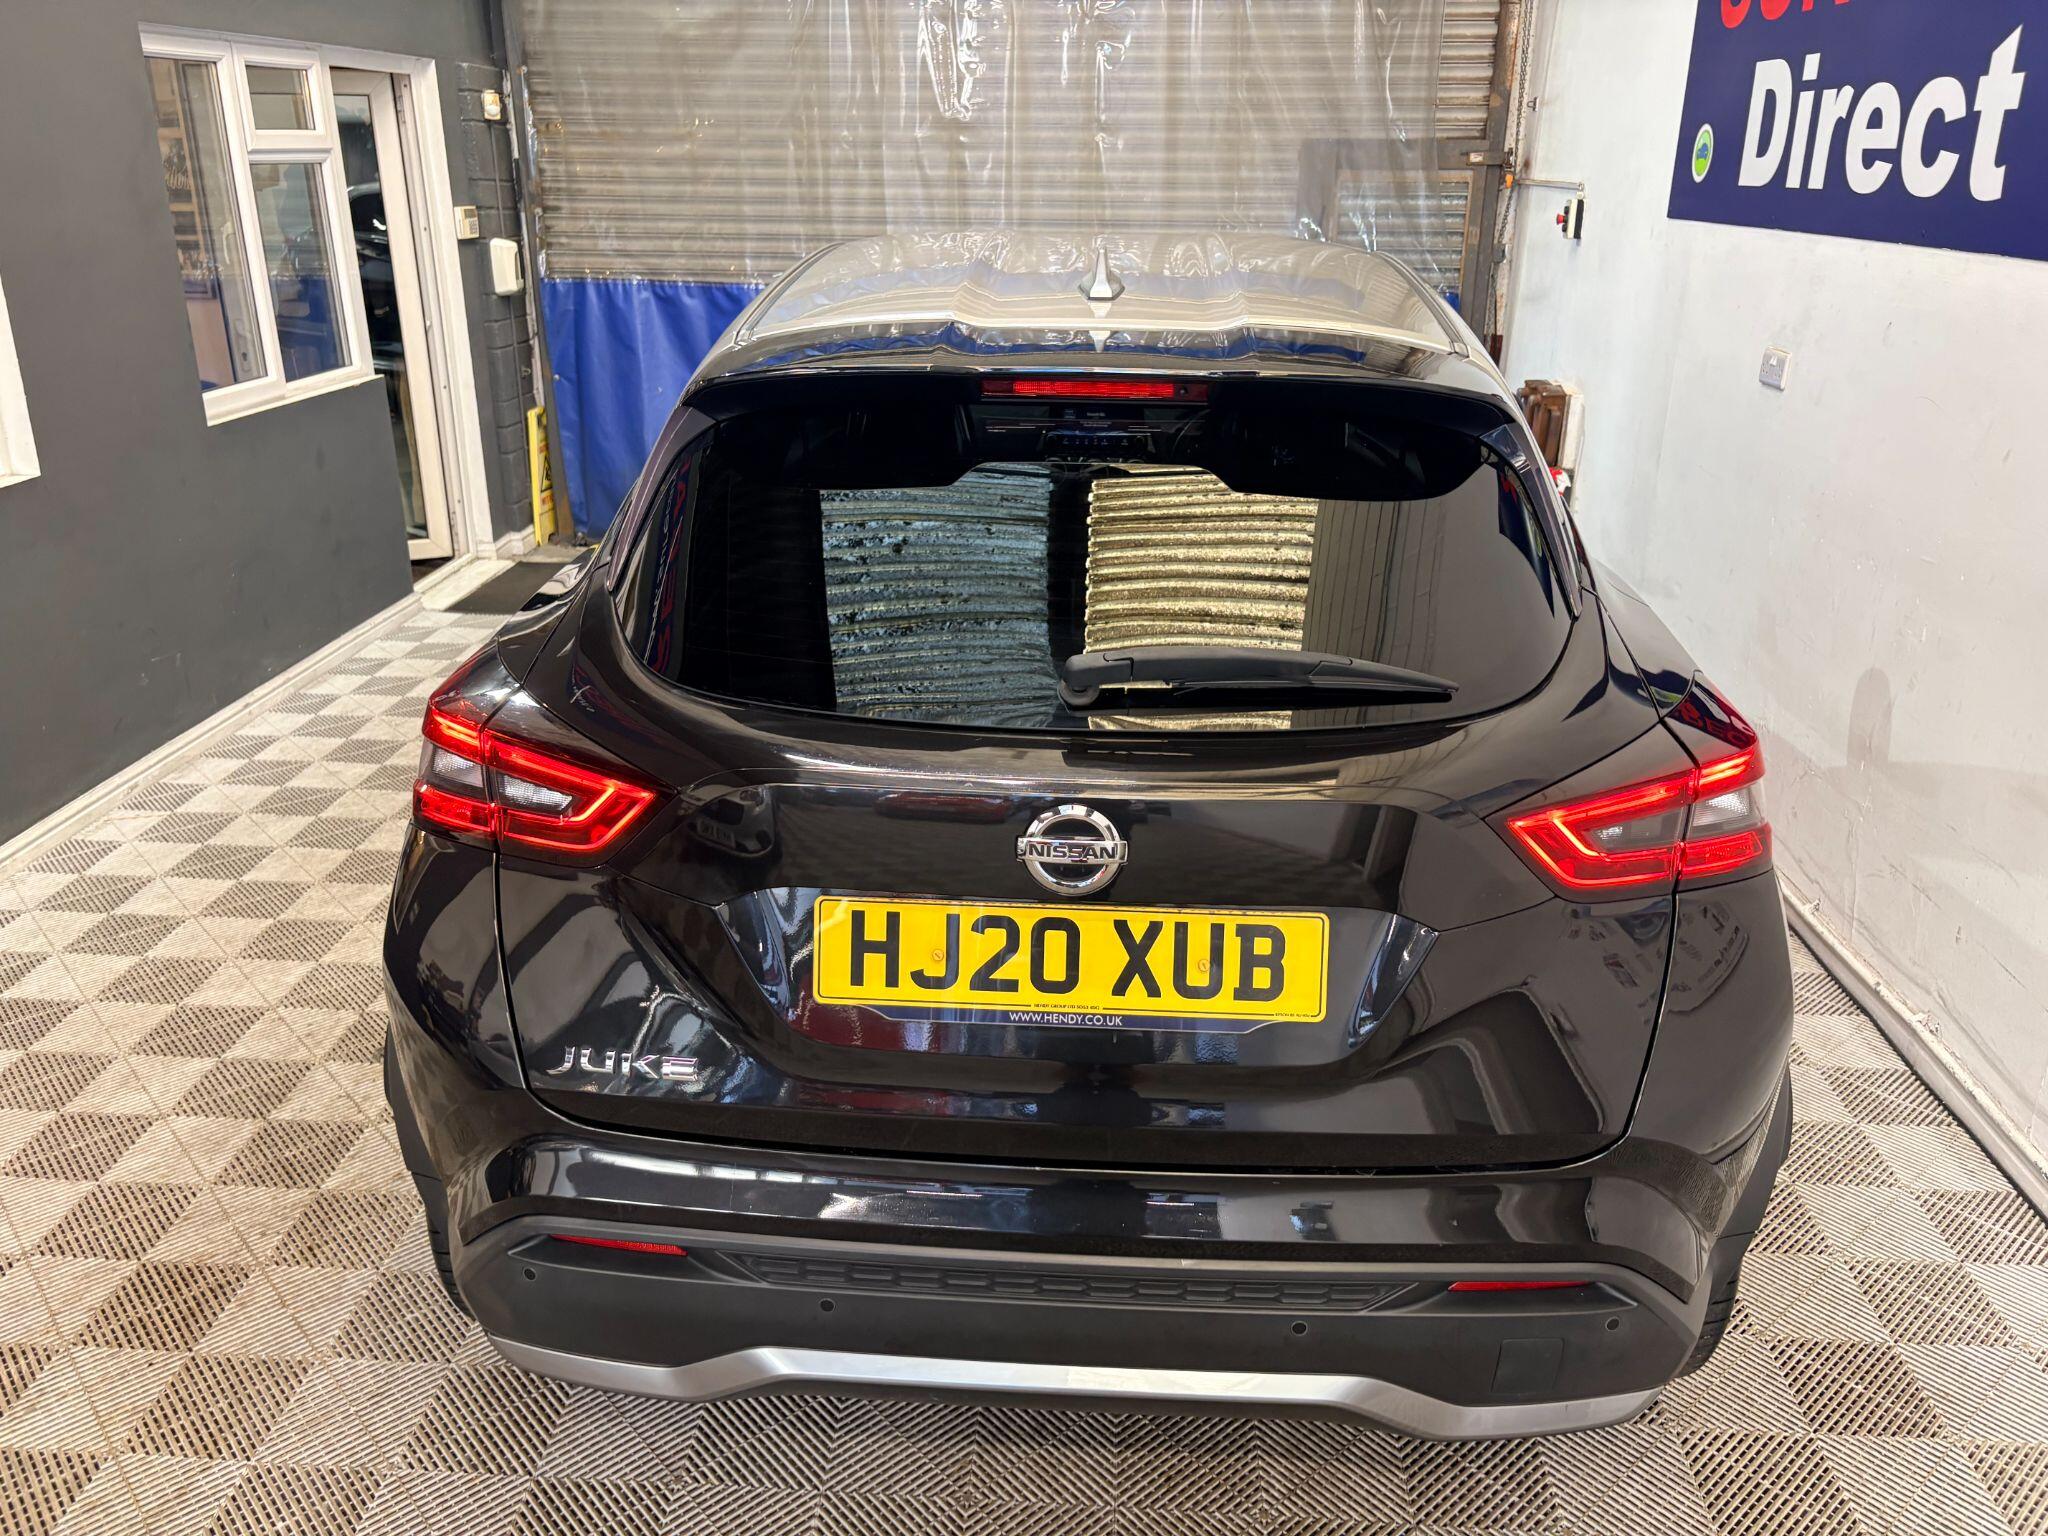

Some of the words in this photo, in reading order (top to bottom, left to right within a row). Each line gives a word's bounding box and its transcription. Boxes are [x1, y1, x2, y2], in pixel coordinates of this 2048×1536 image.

[1737, 24, 2026, 202] Direct
[1028, 842, 1116, 860] NISSAN
[849, 909, 1081, 995] HJ20
[1112, 918, 1286, 1002] XUB
[1008, 1012, 1122, 1026] WWW.HENDY.CO.UK
[545, 1046, 698, 1082] JUKE
